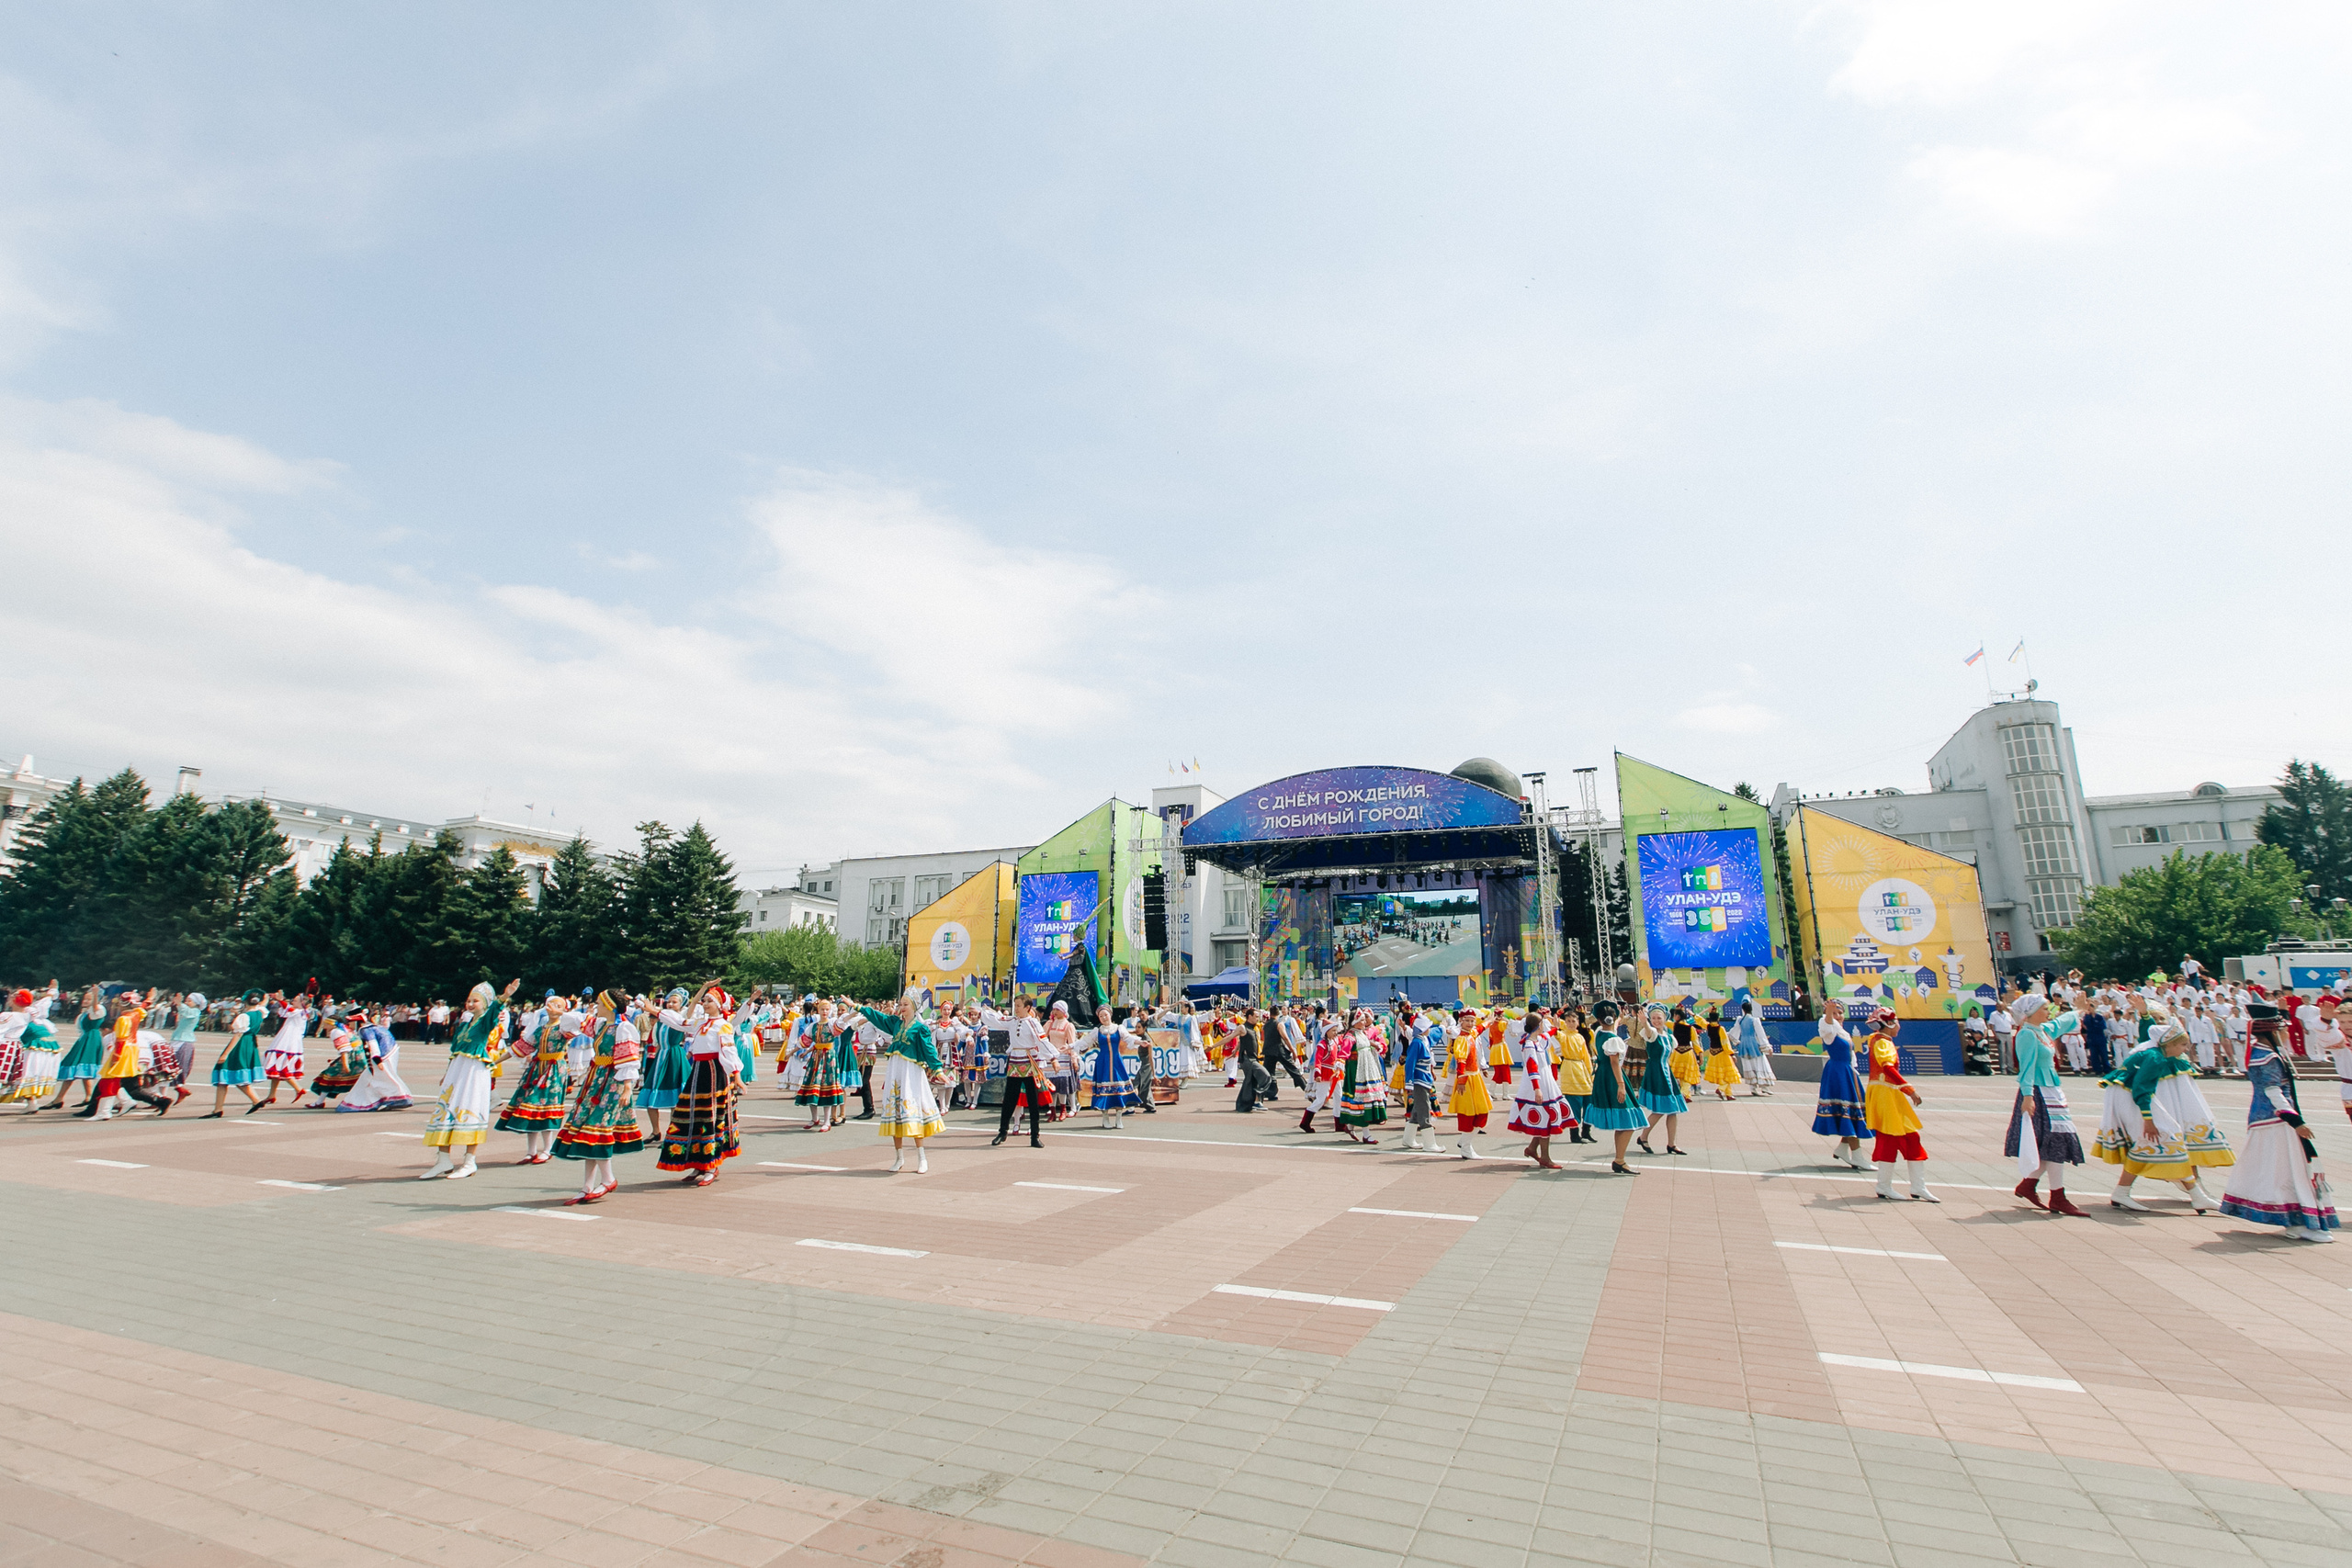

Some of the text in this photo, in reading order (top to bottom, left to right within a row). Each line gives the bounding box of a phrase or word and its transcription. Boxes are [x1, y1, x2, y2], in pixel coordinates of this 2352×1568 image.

[1258, 784, 1430, 810] С ДНЁМ РОЖДЕНИЯ,
[1262, 806, 1424, 829] ЛЮБИМЫЙ ГОРОД!
[1666, 892, 1741, 906] УЛАН-УДЭ
